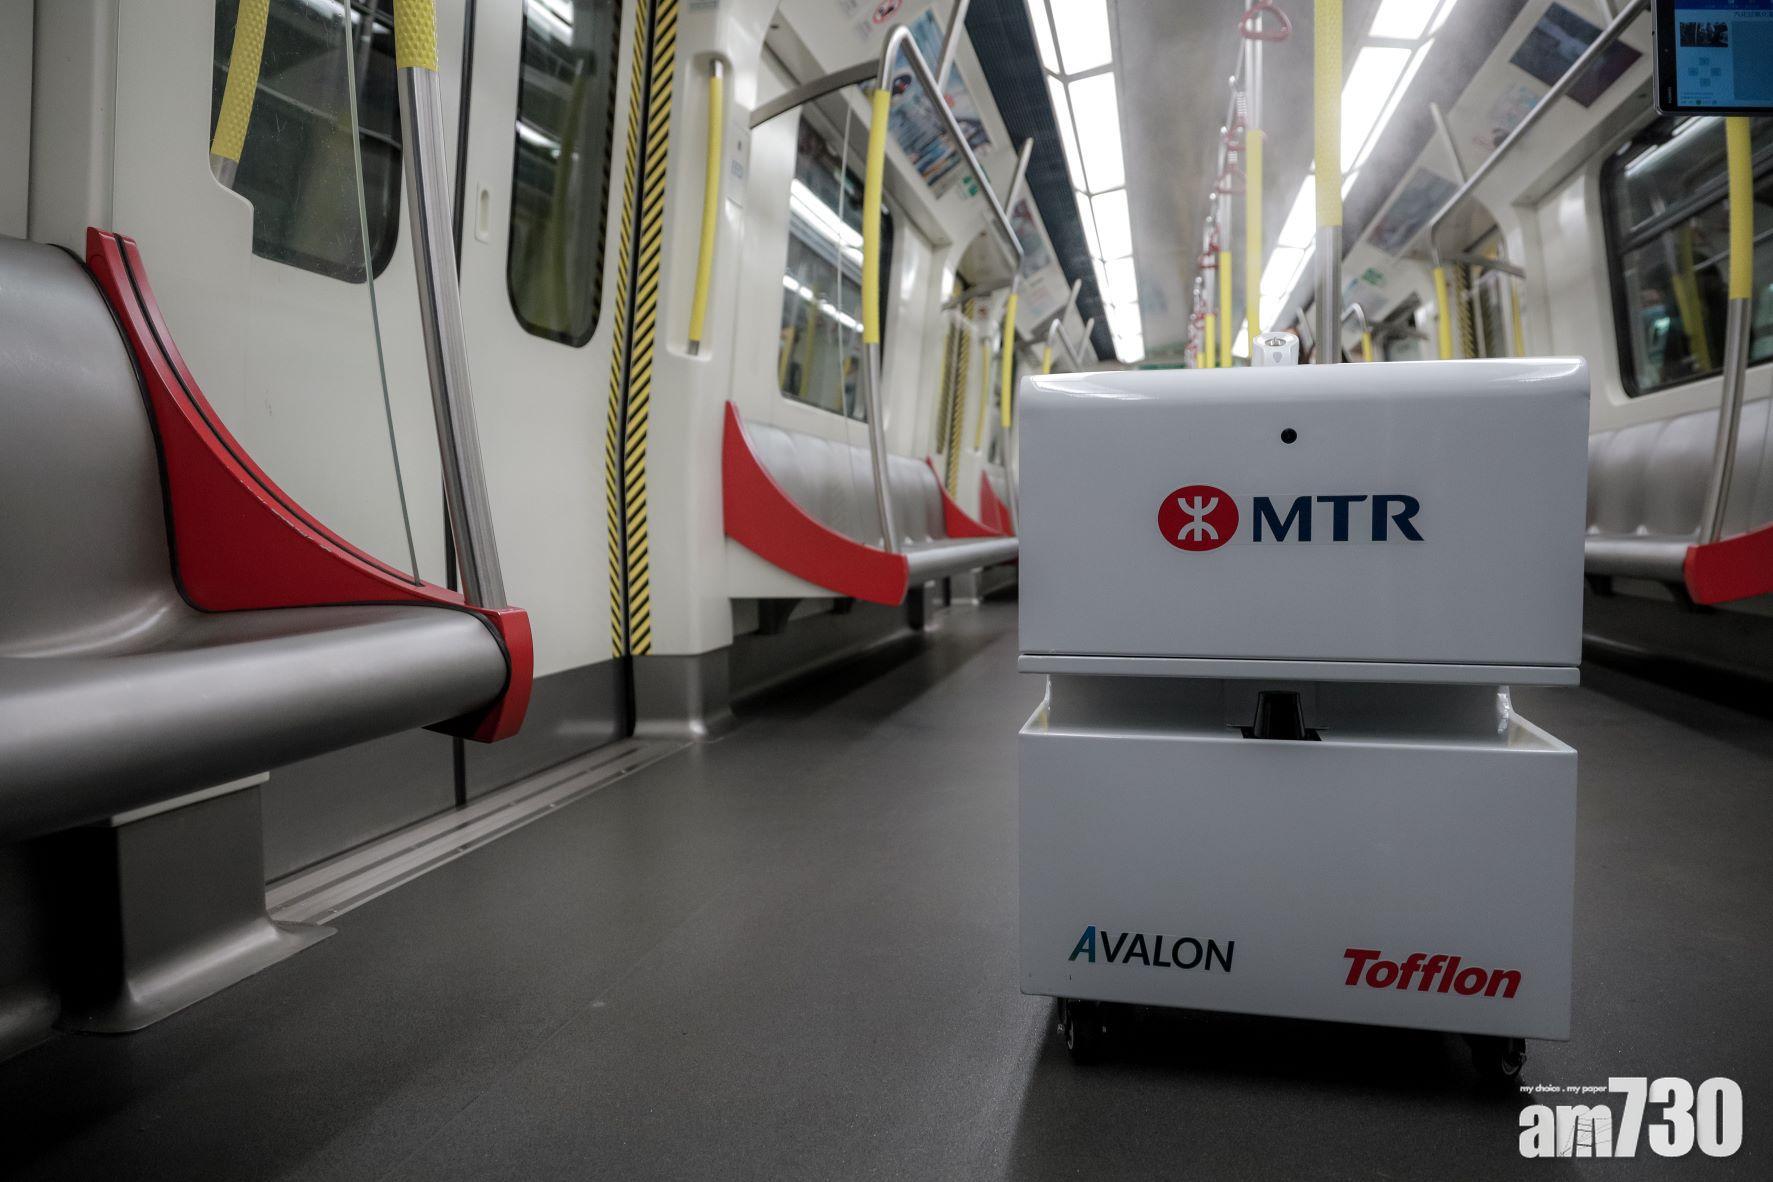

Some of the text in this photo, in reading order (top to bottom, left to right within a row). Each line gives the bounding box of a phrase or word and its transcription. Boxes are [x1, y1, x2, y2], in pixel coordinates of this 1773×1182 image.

[1253, 495, 1424, 542] MTR
[1068, 926, 1235, 972] AVALON
[1344, 948, 1521, 998] Tofflon
